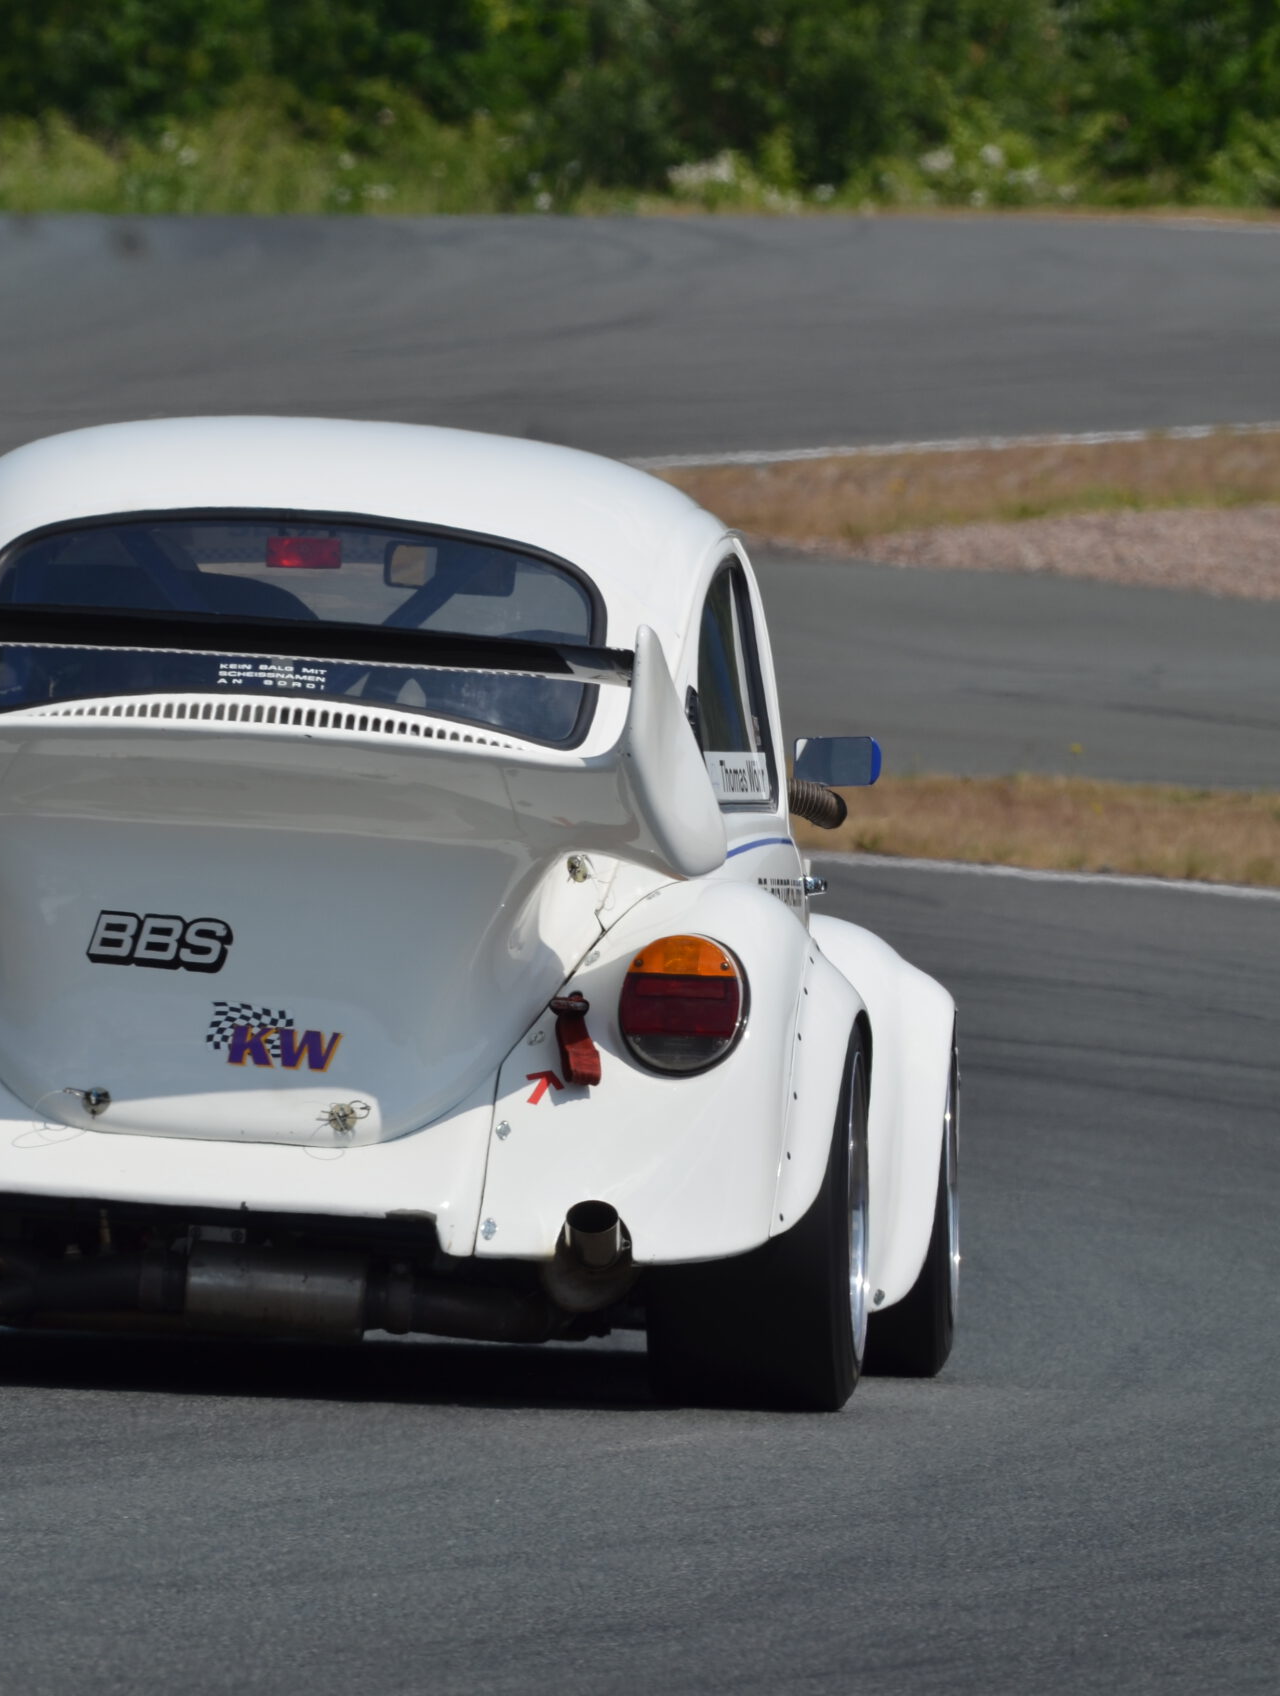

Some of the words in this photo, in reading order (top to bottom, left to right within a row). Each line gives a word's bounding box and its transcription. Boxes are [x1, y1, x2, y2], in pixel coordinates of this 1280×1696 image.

[218, 670, 326, 683] SCHEISSNAMEN
[258, 664, 294, 672] BALG
[301, 667, 327, 675] MIT
[263, 679, 325, 691] BORD!
[719, 759, 748, 792] Thomas
[86, 909, 234, 974] BBS
[227, 1023, 344, 1073] KW
